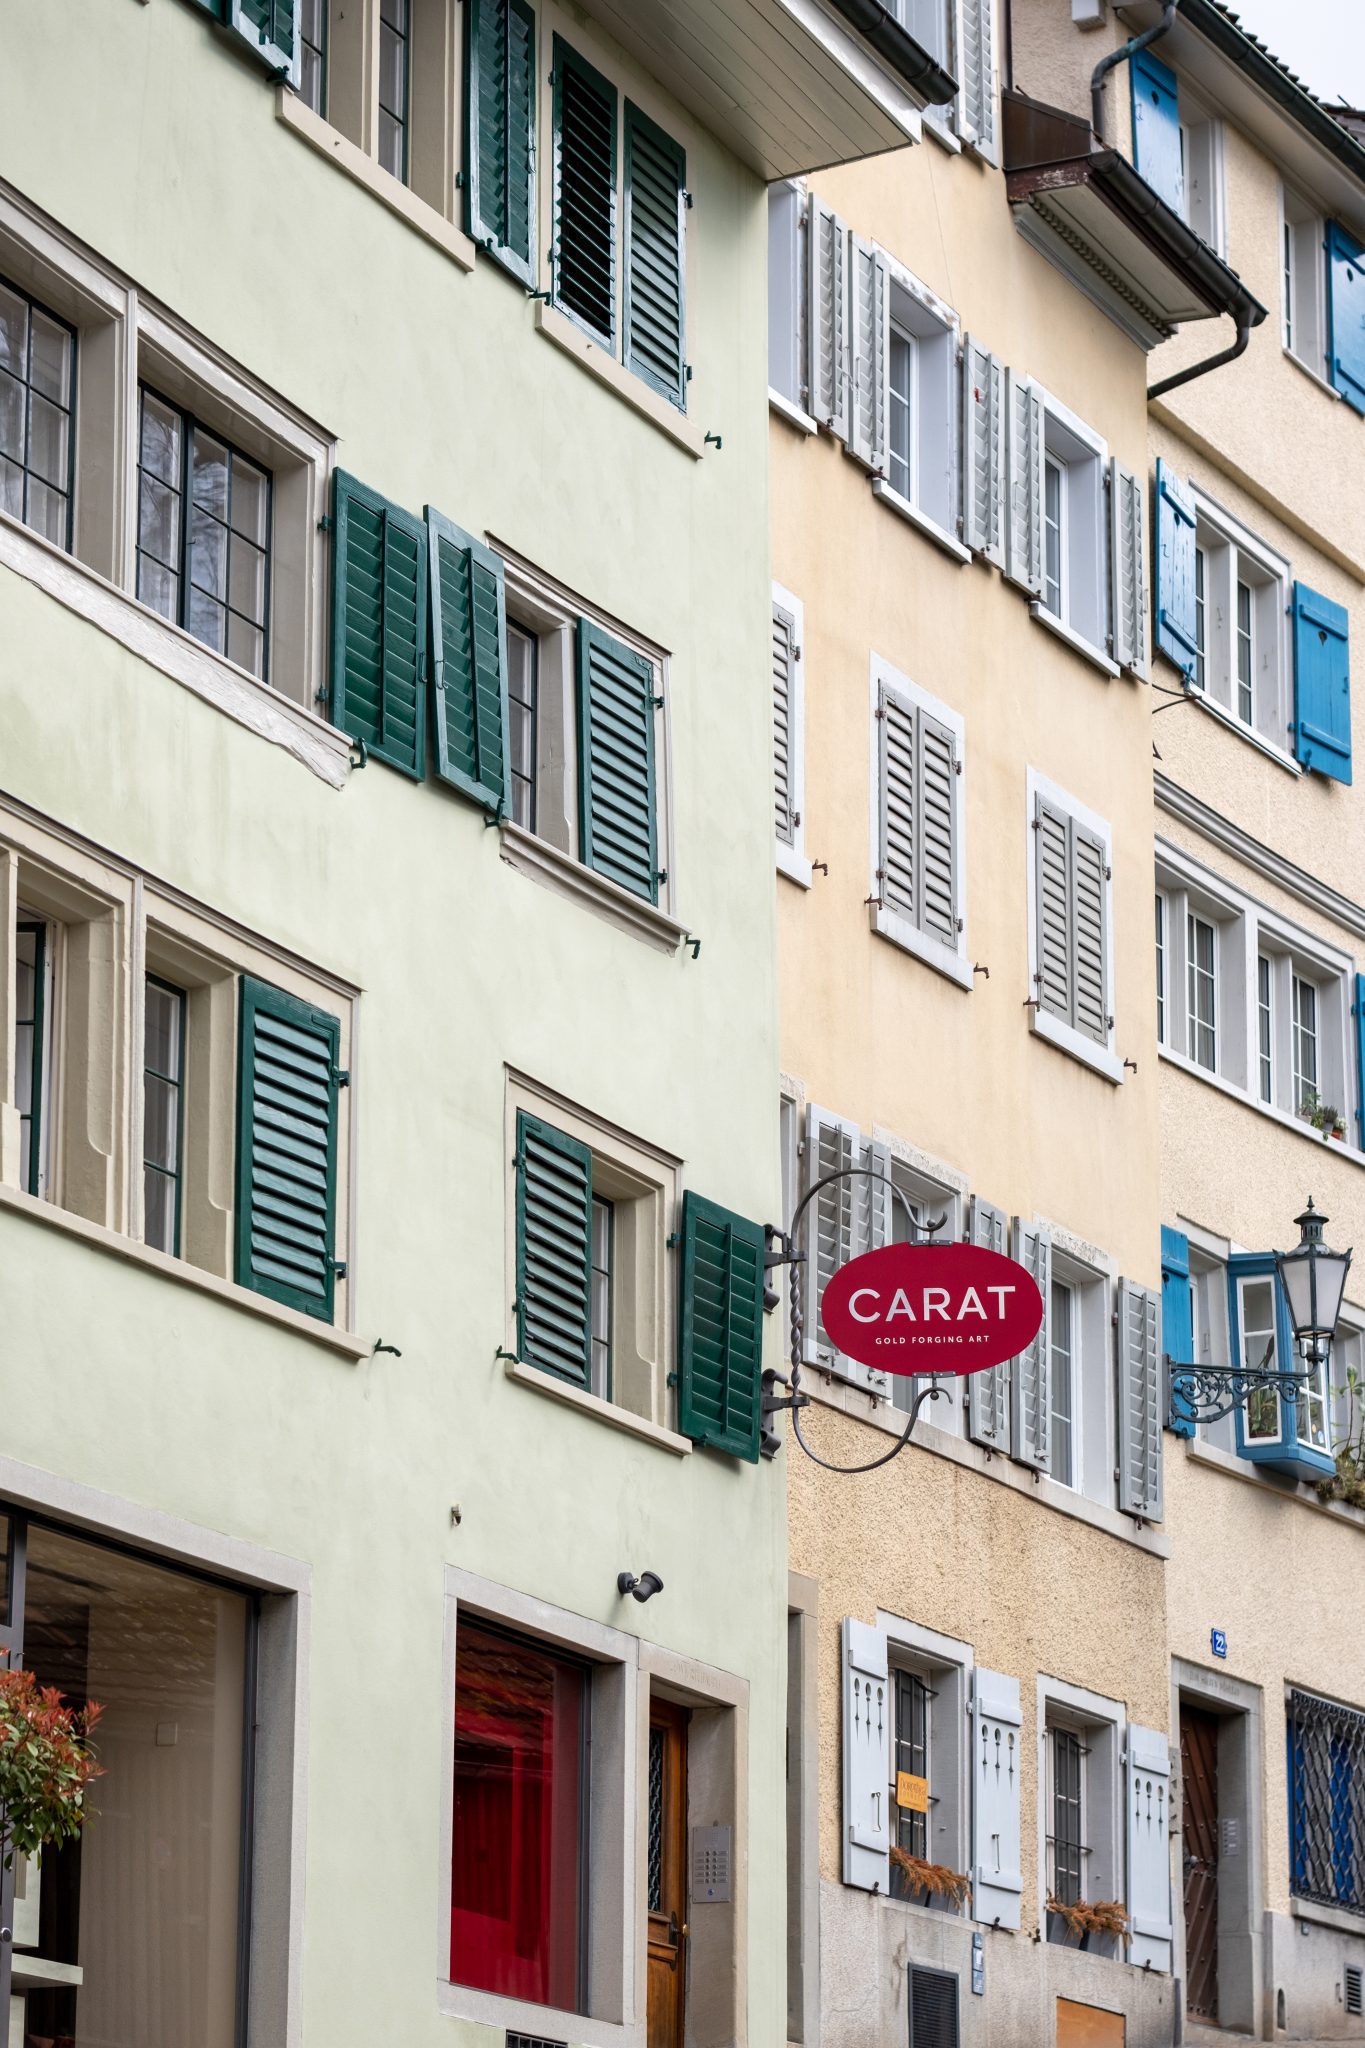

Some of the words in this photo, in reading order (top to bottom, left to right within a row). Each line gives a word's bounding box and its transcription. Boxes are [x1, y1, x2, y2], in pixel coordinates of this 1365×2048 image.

[848, 1286, 1016, 1323] CARAT
[875, 1337, 906, 1345] GOLD
[911, 1336, 963, 1344] FORGING
[968, 1335, 990, 1343] ART
[1215, 1633, 1226, 1653] 22
